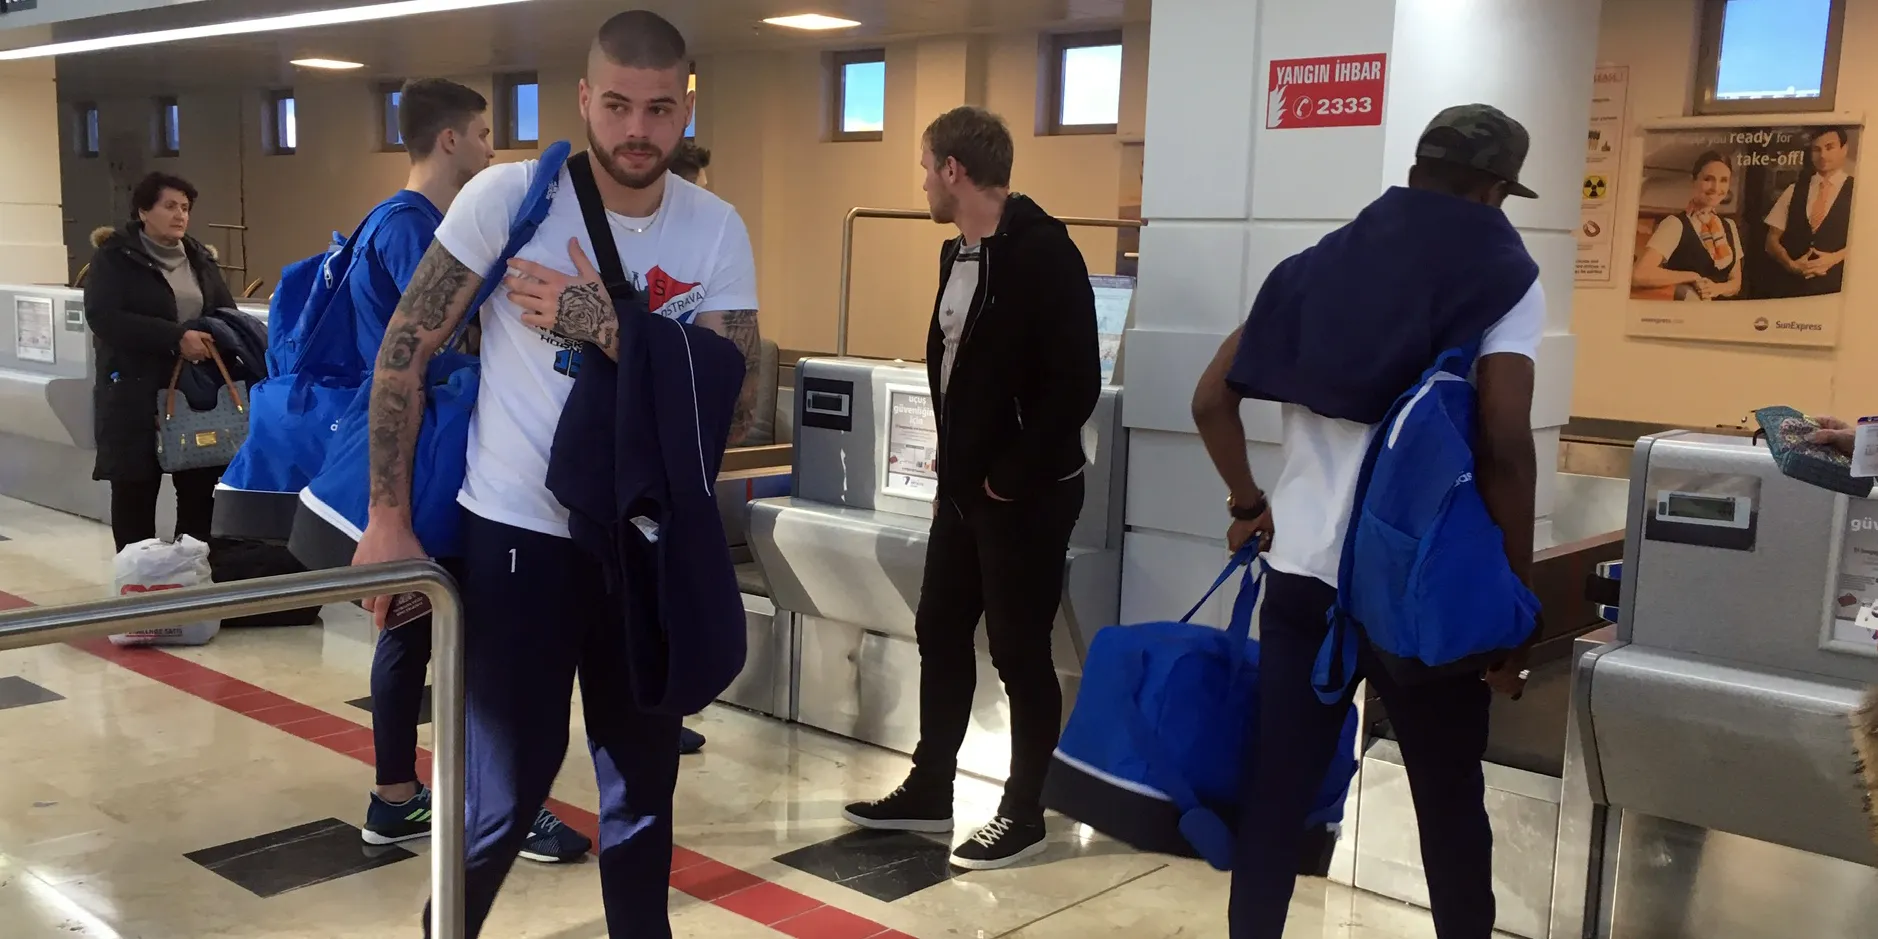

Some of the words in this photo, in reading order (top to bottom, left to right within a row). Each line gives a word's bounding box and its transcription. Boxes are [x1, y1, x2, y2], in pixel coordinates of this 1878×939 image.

[1276, 63, 1330, 85] YANGIN
[1335, 60, 1381, 82] İHBAR
[1316, 97, 1372, 115] 2333
[1729, 130, 1773, 147] ready
[1776, 131, 1793, 143] for
[1736, 150, 1805, 166] take-off!
[661, 291, 704, 317] OSTRAVA
[1775, 320, 1822, 332] SunExpress
[908, 396, 927, 406] uçuş
[508, 548, 517, 573] 1
